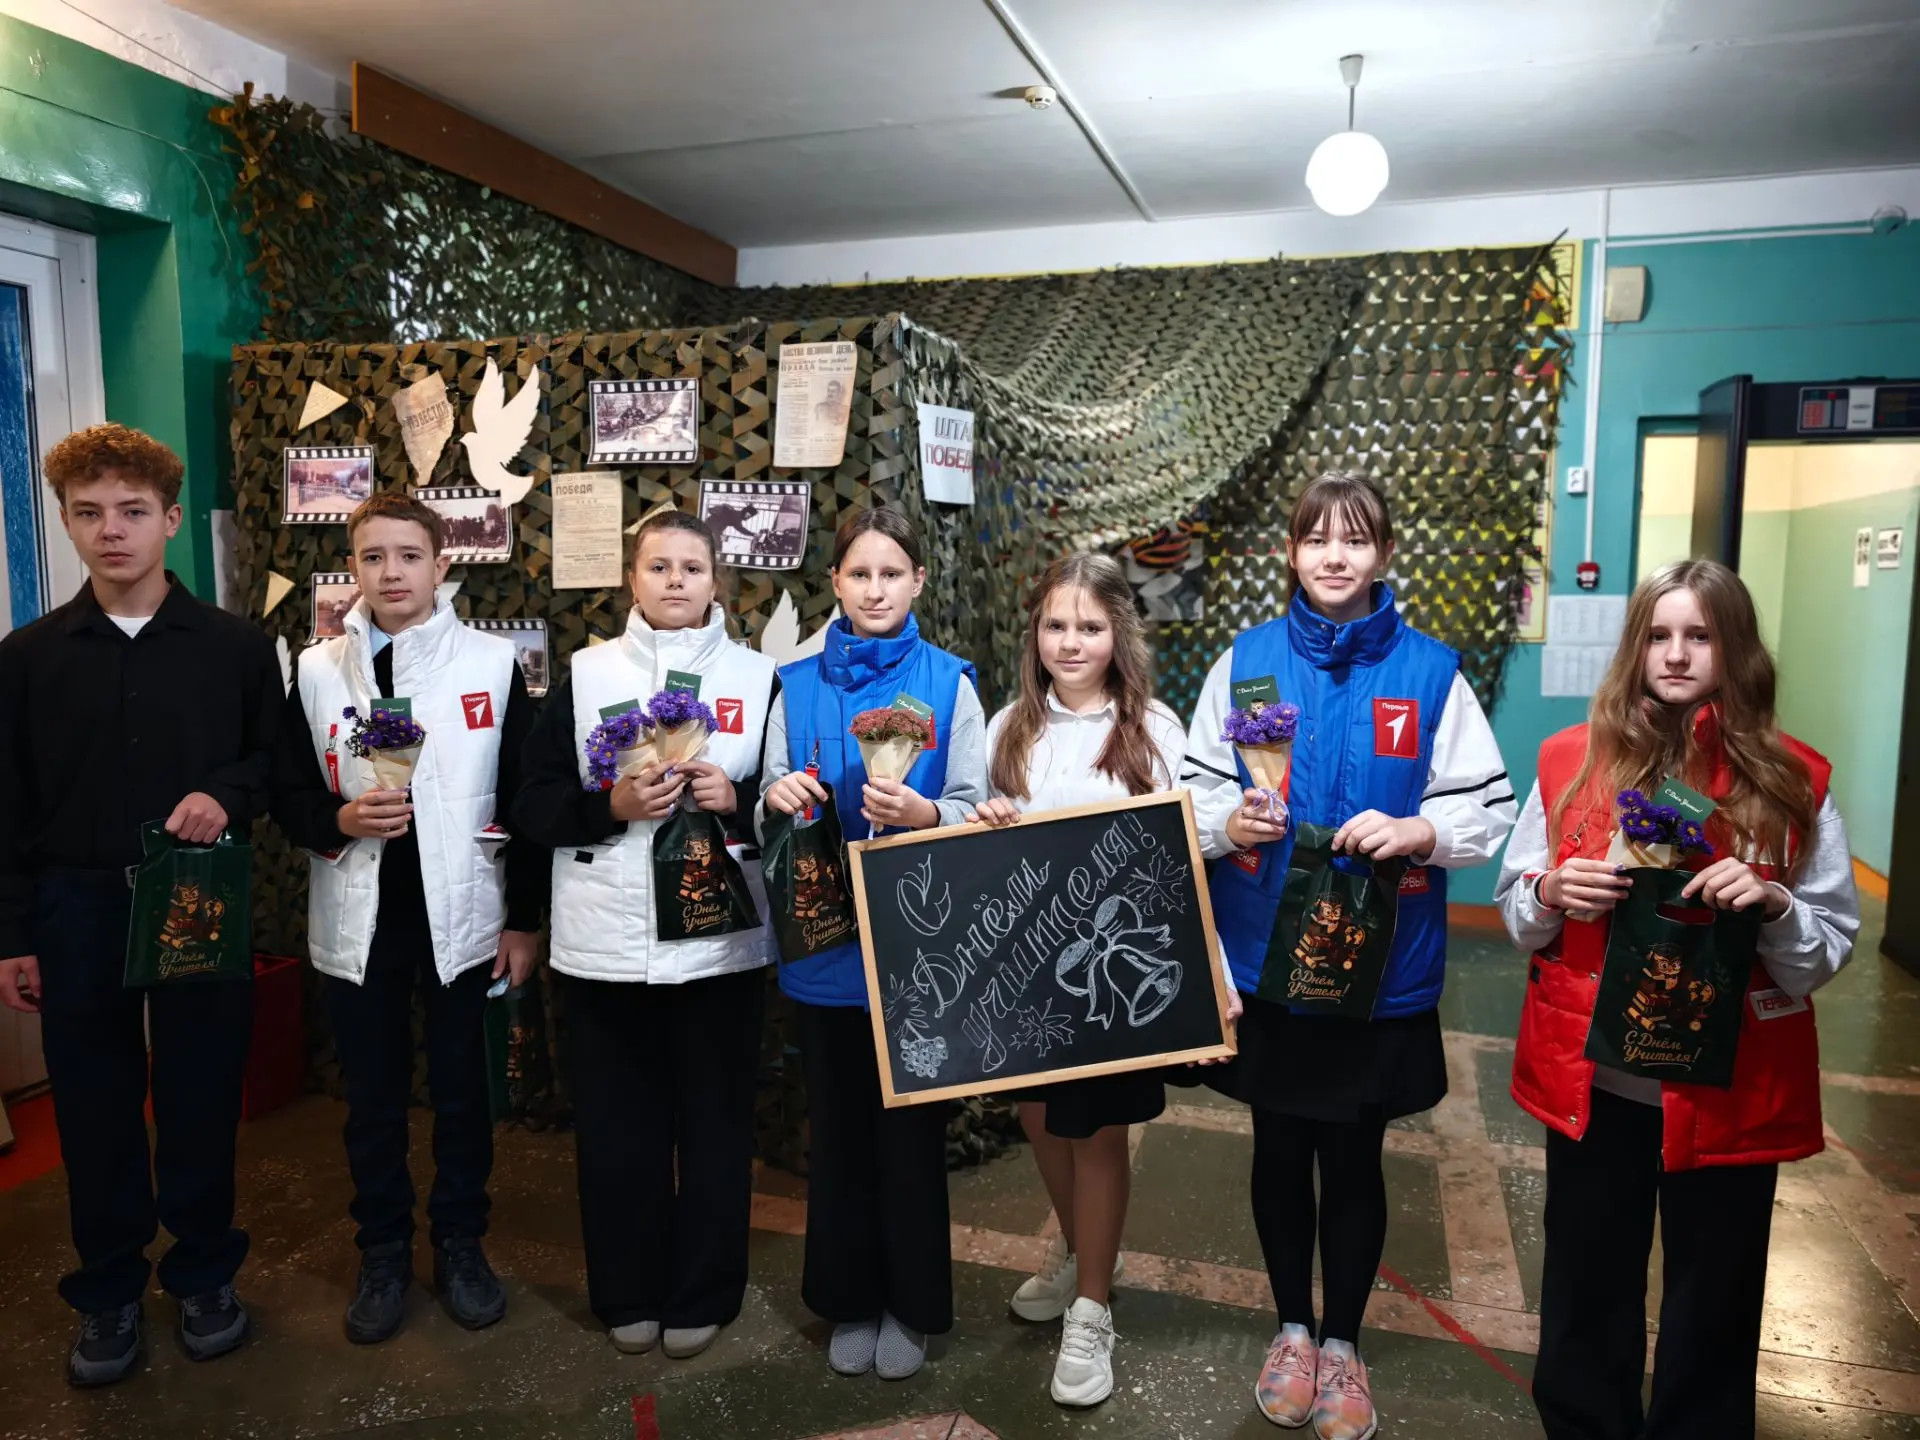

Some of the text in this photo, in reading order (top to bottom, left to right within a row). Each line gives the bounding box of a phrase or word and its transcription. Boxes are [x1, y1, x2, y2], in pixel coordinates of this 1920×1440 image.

[406, 400, 450, 430] ИЗВЕСТИЯ
[897, 853, 951, 936] С
[682, 905, 692, 919] С
[802, 914, 842, 937] С Днём
[912, 857, 1050, 1018] Днём
[1289, 968, 1335, 986] С Днём
[1287, 981, 1350, 998] Учителя!
[1624, 1031, 1682, 1050] С Днём
[1624, 1045, 1702, 1064] Учителя!
